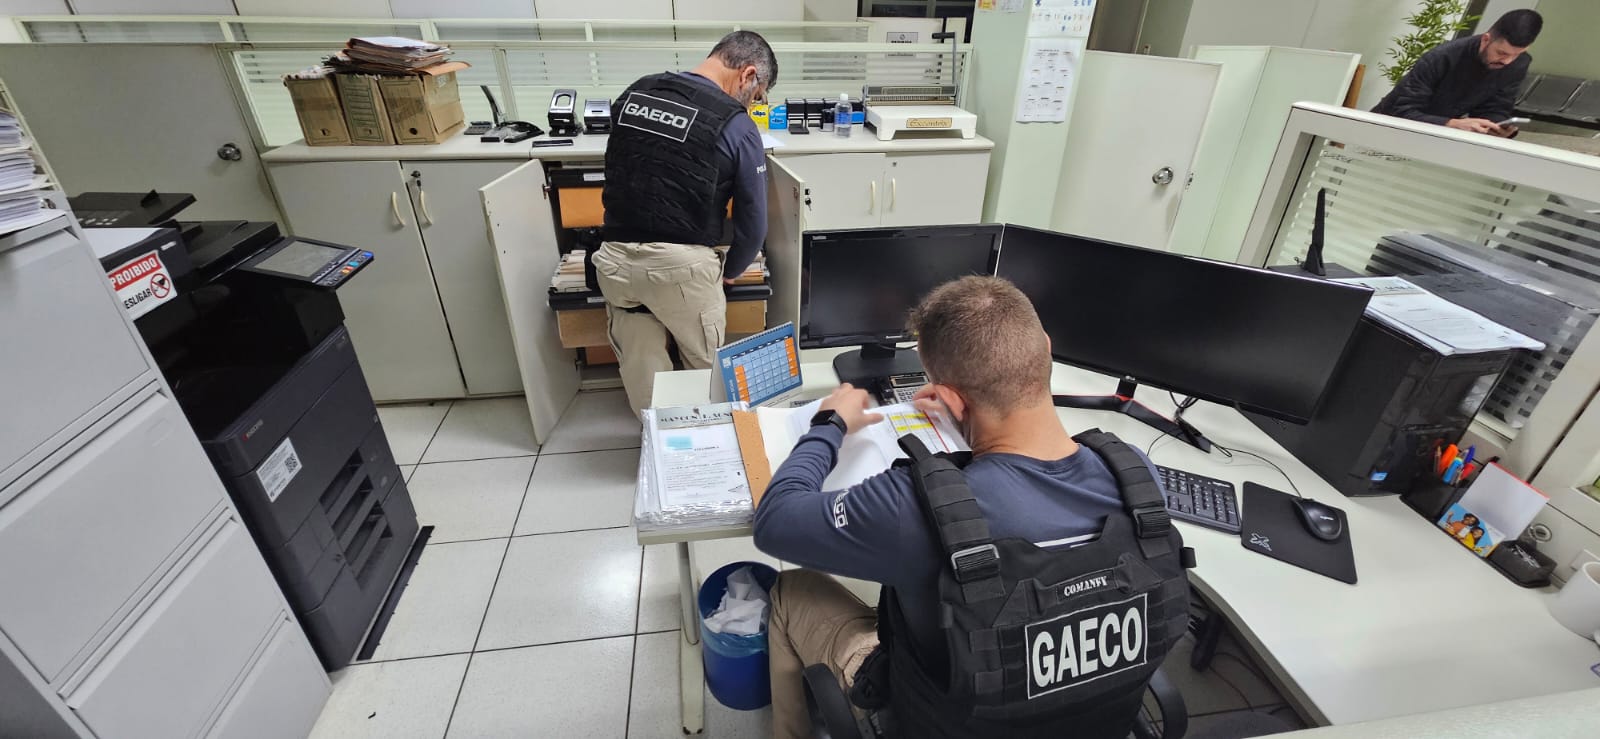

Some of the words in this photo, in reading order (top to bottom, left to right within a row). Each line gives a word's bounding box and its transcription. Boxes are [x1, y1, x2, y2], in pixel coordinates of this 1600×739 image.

[624, 102, 689, 129] GAECO
[756, 162, 767, 174] POL
[123, 287, 153, 310] ESLIGAR
[834, 489, 850, 528] AECO
[1032, 607, 1143, 688] GAECO
